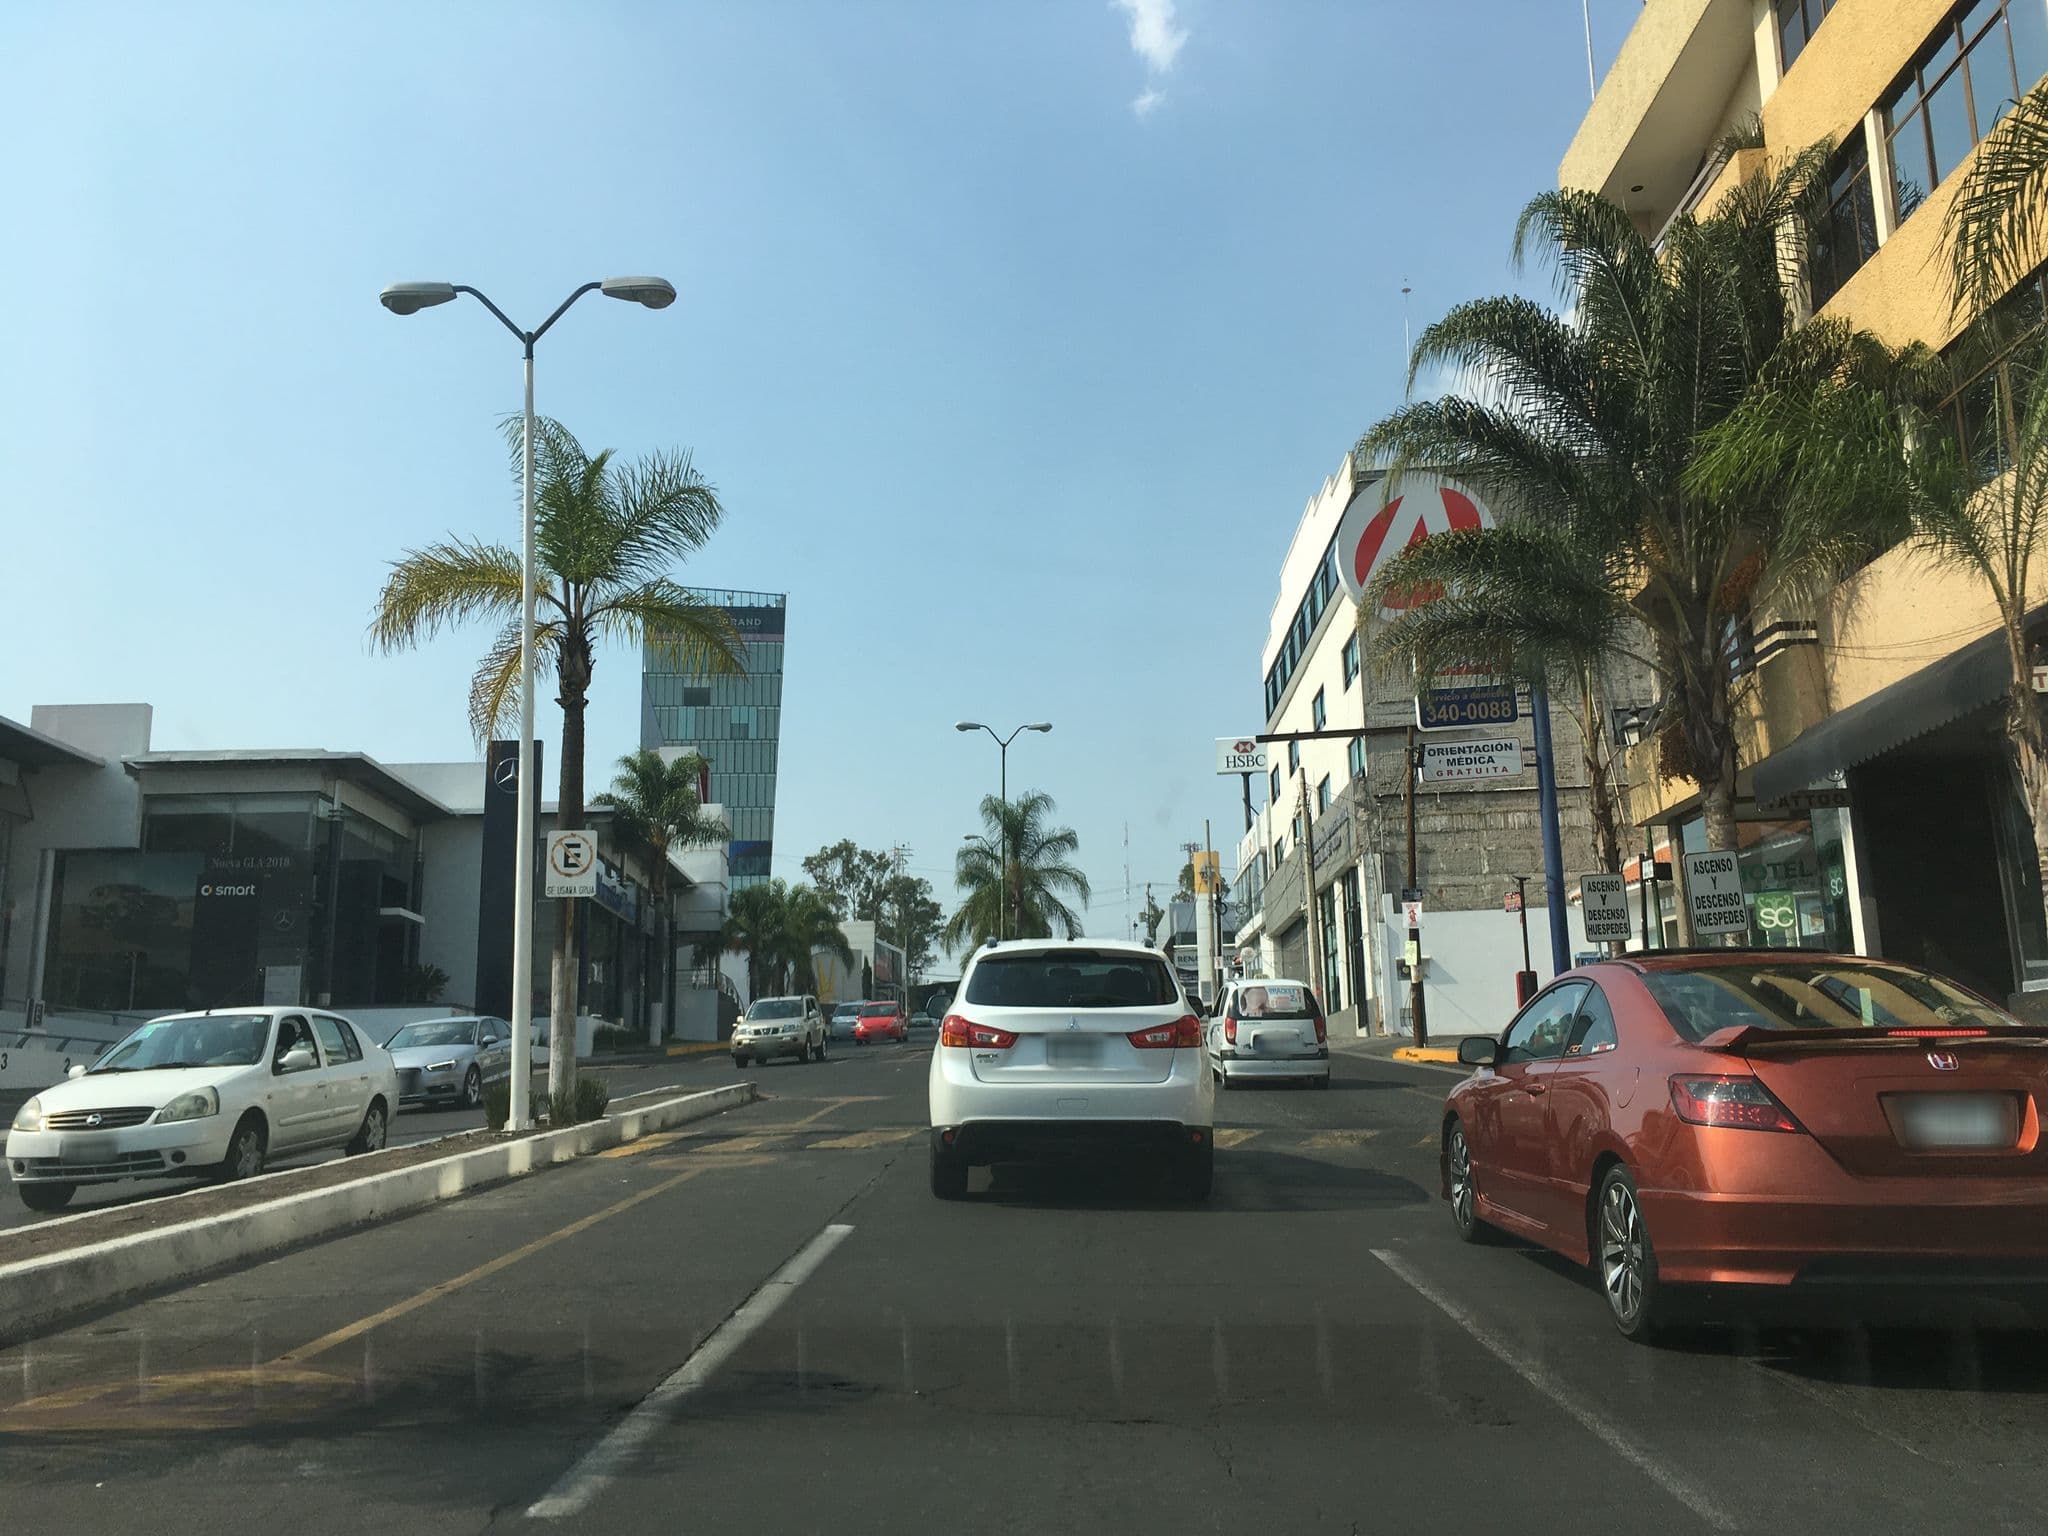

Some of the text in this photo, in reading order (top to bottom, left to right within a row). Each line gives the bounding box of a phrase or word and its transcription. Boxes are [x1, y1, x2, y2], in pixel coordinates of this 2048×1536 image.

[1426, 700, 1512, 723] 340-0088
[1427, 741, 1513, 757] ORIENTACIÓN
[1226, 754, 1266, 769] HSBC
[1446, 755, 1496, 767] MÉDICA
[1436, 766, 1509, 777] GRATUITA
[1693, 858, 1733, 875] ASCENSO
[215, 884, 256, 896] smart
[1587, 880, 1620, 892] ASCENSO
[1710, 876, 1717, 890] Y
[1600, 894, 1607, 906] Y
[1695, 892, 1740, 910] DESCENSO
[1588, 909, 1626, 921] DESCENSO
[1695, 909, 1745, 928] HUESPEDES
[1759, 906, 1794, 929] SC
[1587, 922, 1629, 936] HUESPEDES
[0, 1052, 8, 1070] 3
[63, 1057, 71, 1074] 2
